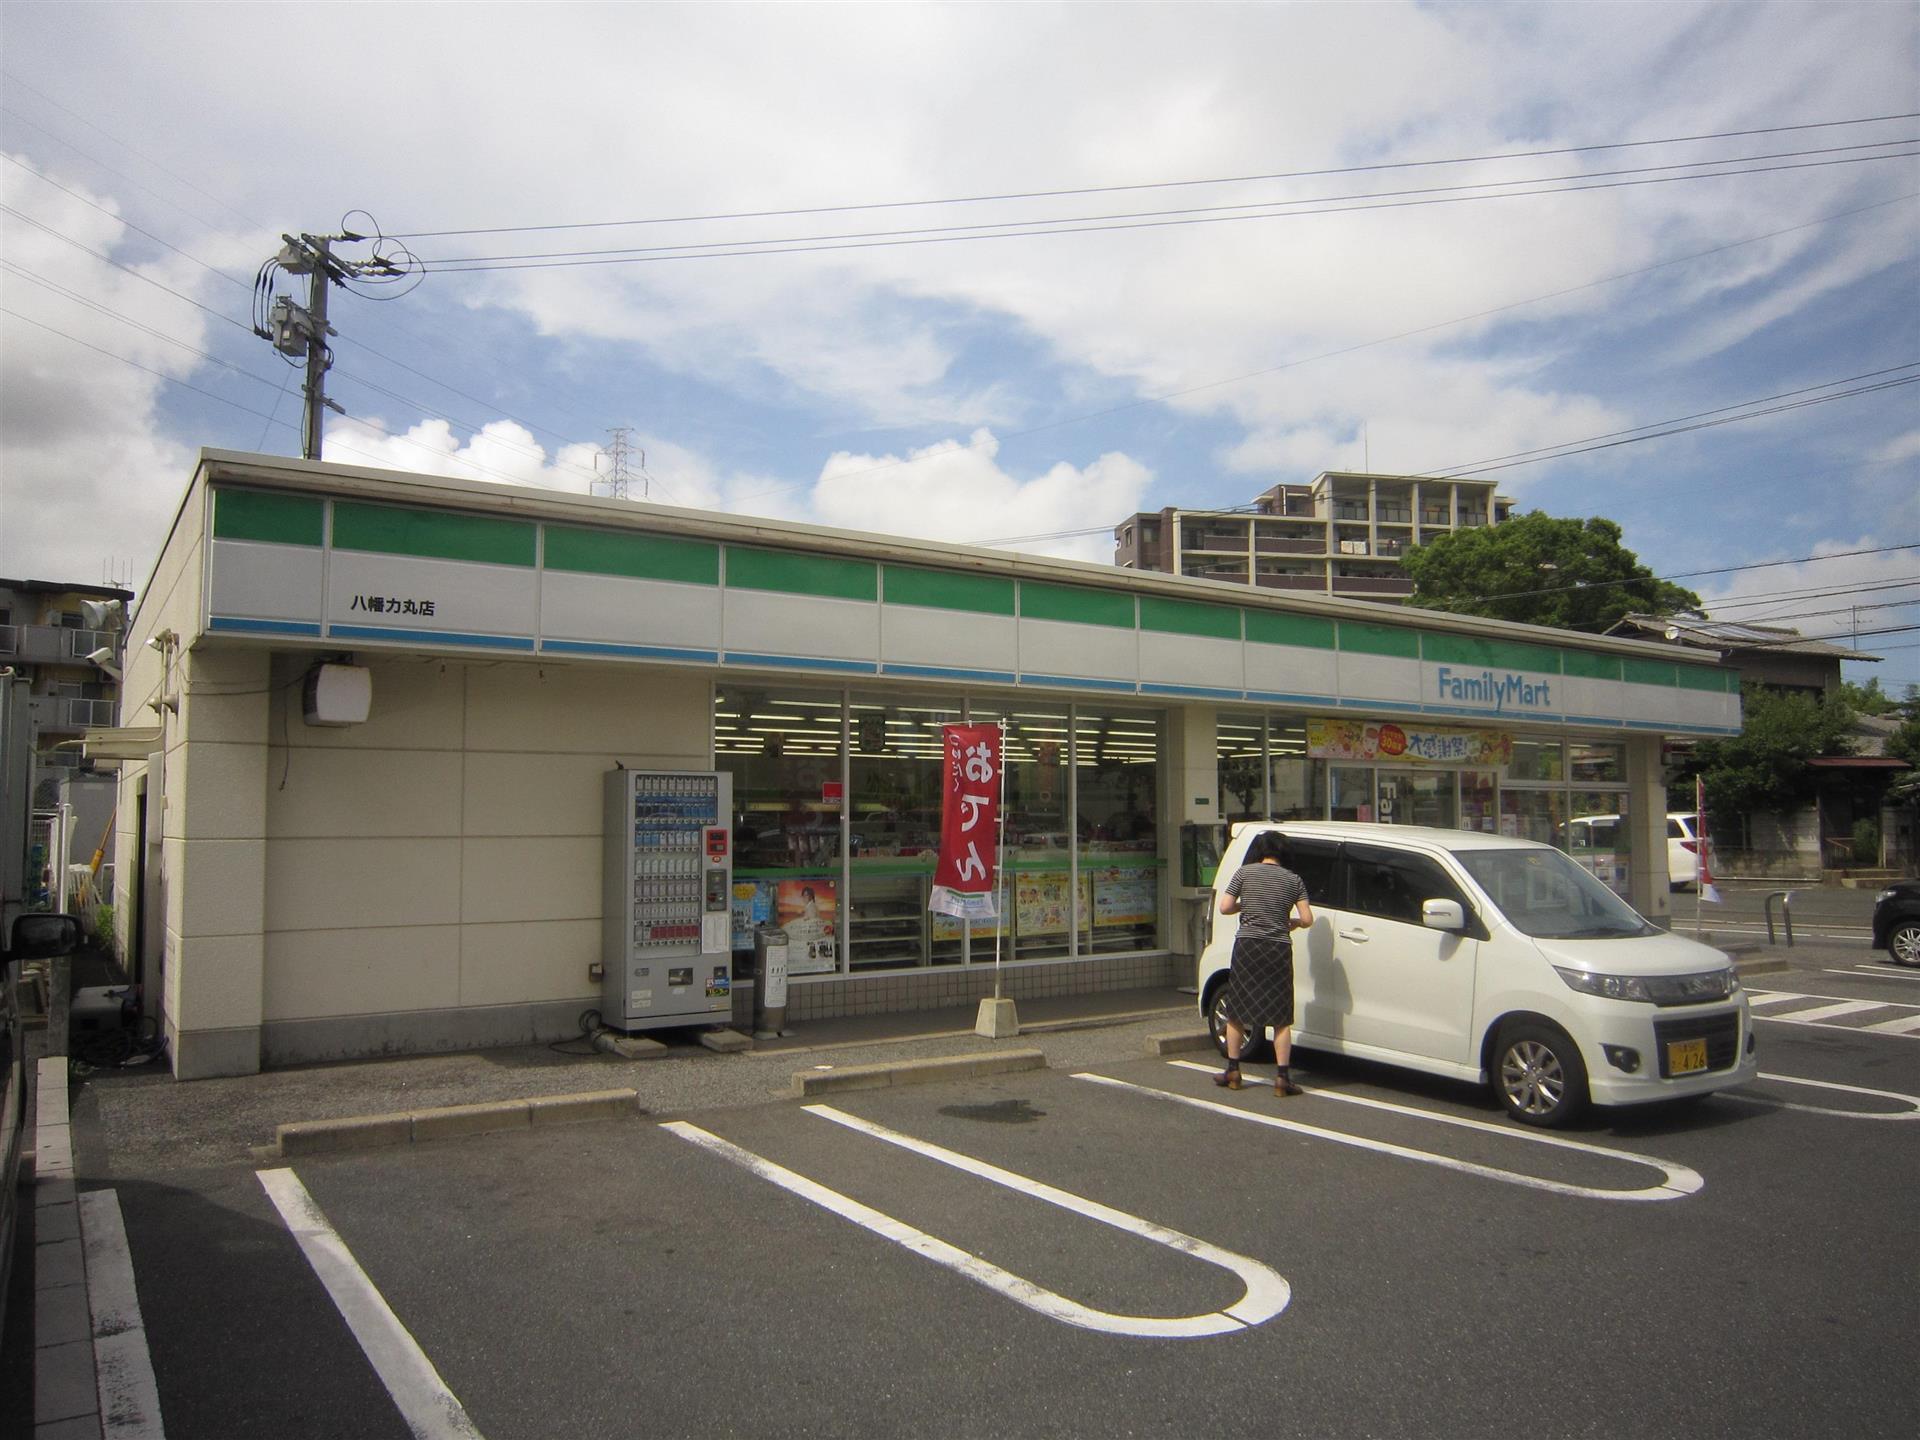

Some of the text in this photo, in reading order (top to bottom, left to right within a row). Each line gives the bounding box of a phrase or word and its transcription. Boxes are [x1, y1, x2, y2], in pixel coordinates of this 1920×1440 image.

[350, 595, 435, 616] 八幡力丸店
[1438, 667, 1550, 711] FamilyMart
